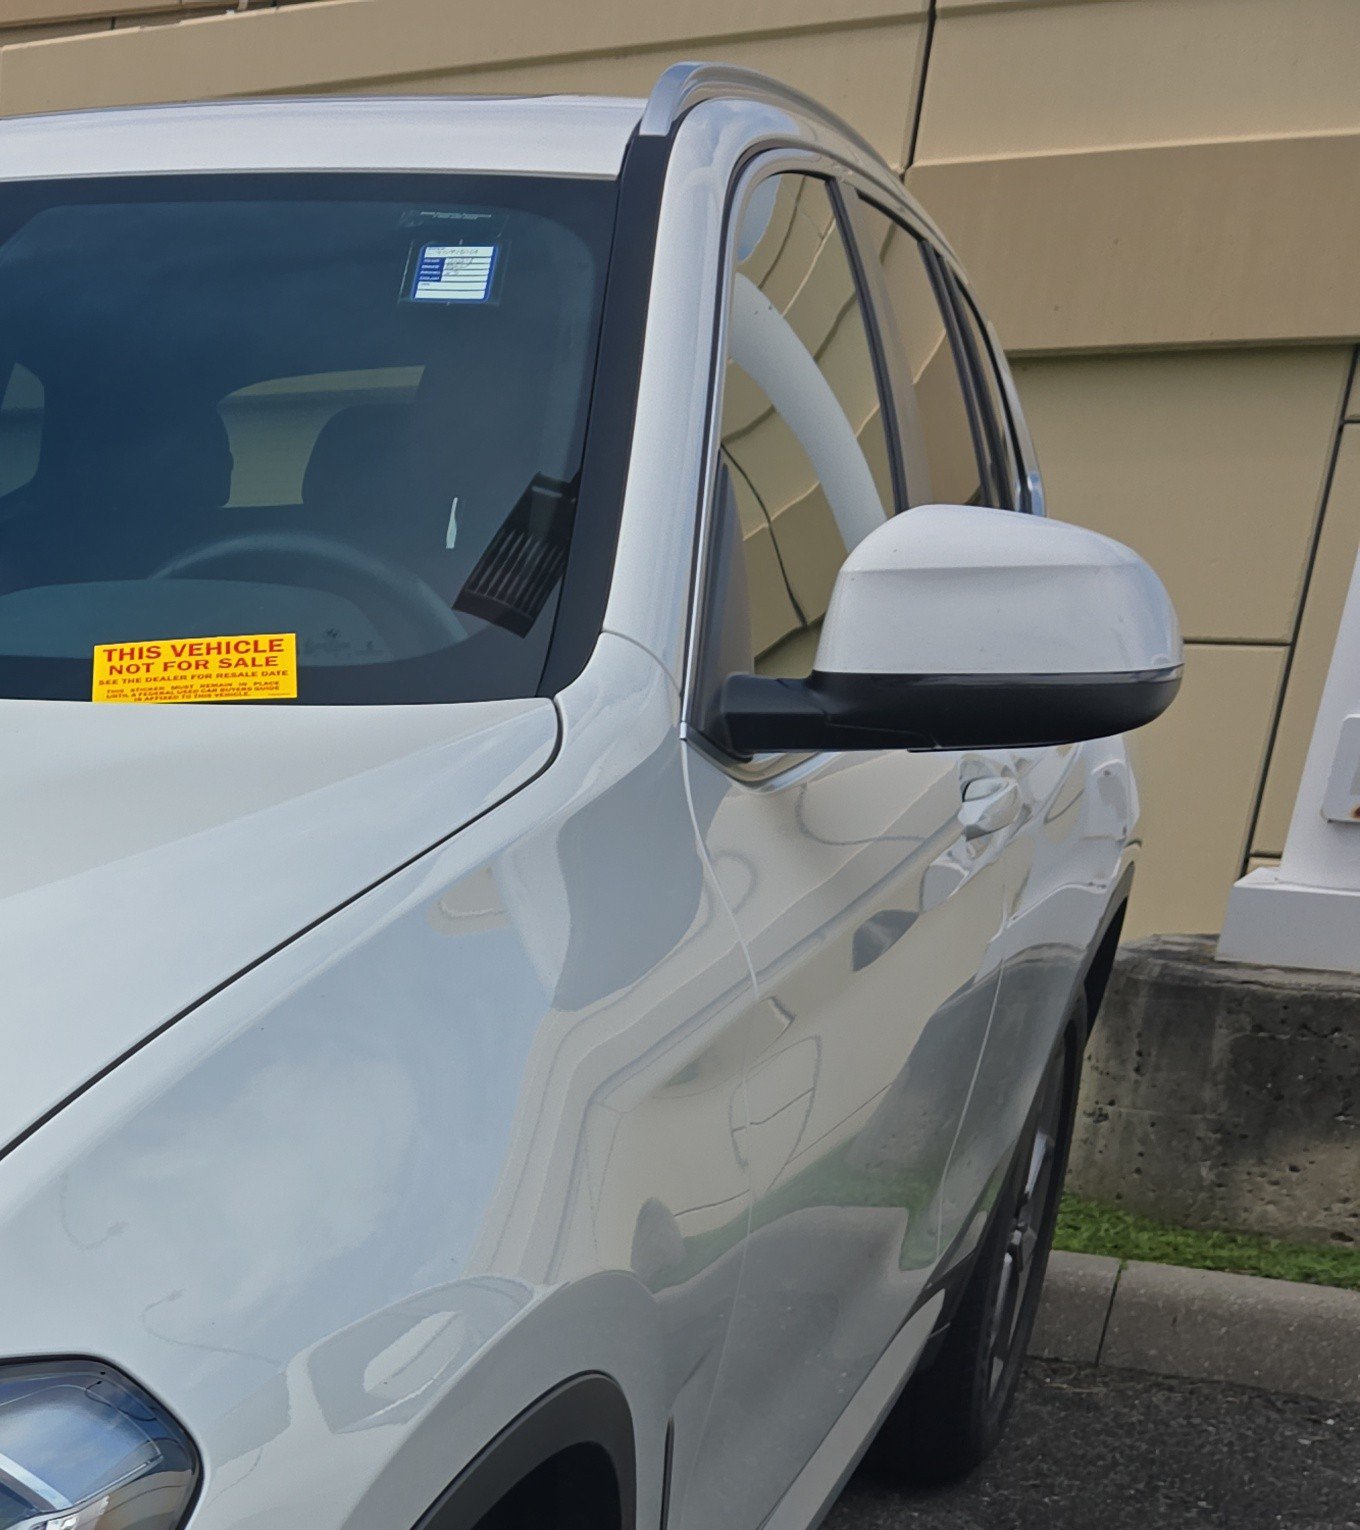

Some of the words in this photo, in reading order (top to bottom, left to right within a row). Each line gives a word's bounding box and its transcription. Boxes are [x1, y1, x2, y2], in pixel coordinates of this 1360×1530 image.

[103, 645, 161, 662] THIS
[170, 638, 284, 658] VEHICLE
[109, 662, 155, 676] NOT
[163, 659, 209, 672] FOR
[218, 655, 279, 669] SALE
[145, 674, 188, 682] DEALER
[216, 671, 258, 679] RESALE
